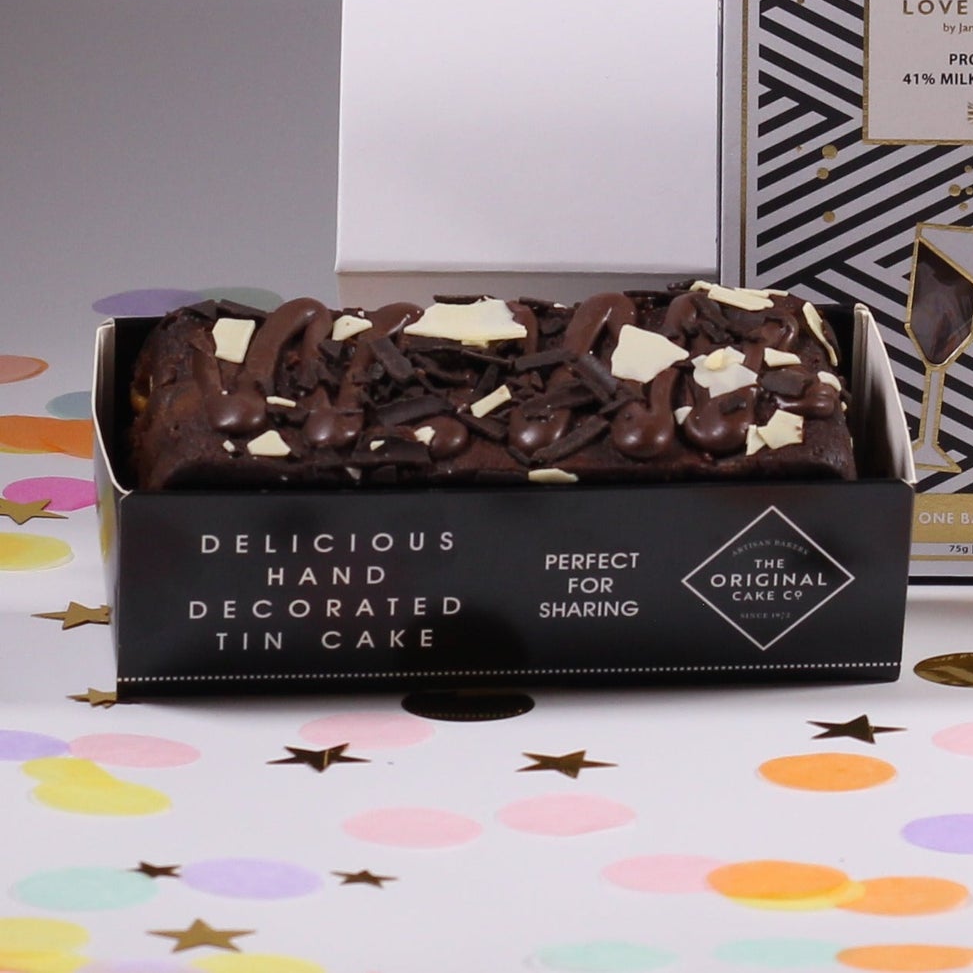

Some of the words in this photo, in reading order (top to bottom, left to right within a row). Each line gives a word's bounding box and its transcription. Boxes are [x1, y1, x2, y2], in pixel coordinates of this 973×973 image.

[902, 0, 968, 16] LOVE
[943, 23, 956, 33] by
[902, 73, 936, 85] 41%
[918, 512, 954, 525] ONE
[200, 531, 454, 554] DELICIOUS
[949, 544, 969, 555] 75g
[544, 551, 640, 571] PERFECT
[754, 558, 785, 570] THE
[267, 565, 385, 586] HAND
[710, 572, 828, 588] ORIGINAL
[567, 577, 613, 594] FOR
[732, 590, 775, 601] CAKE
[188, 596, 462, 619] DECORATED
[539, 600, 640, 619] SHARING
[216, 631, 283, 651] TIN
[321, 629, 434, 649] CAKE
